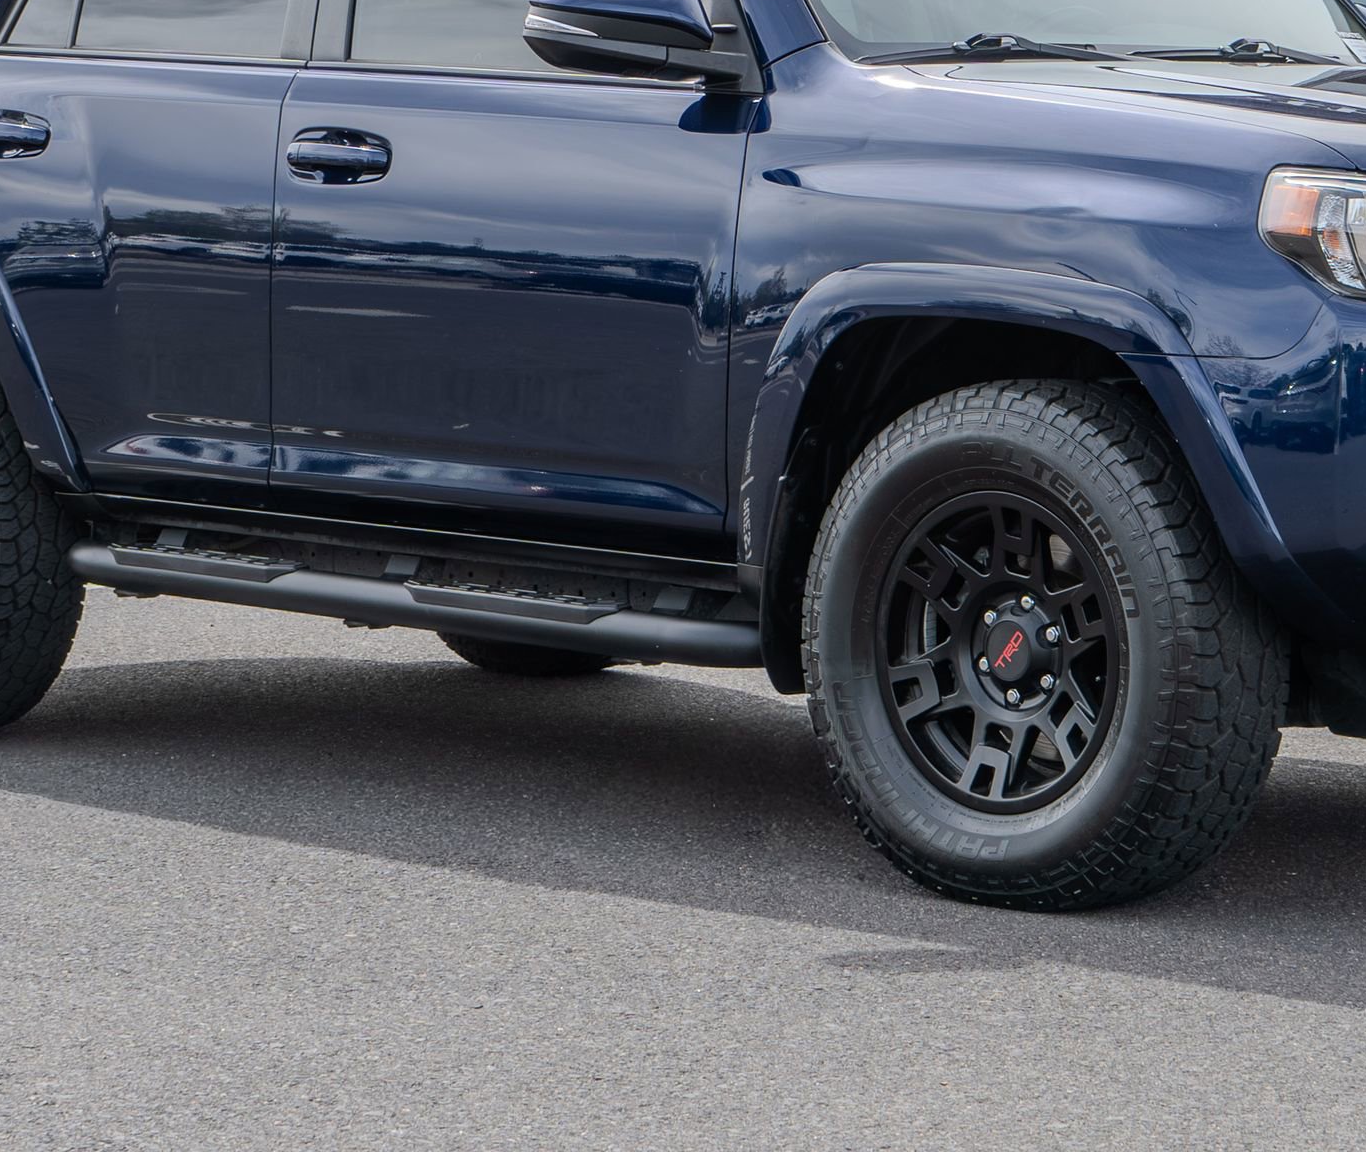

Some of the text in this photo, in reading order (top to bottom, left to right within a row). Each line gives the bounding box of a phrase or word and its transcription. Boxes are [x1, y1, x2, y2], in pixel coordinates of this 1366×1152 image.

[1030, 455, 1141, 619] TERRAIN
[994, 630, 1024, 668] TRD
[833, 680, 1011, 861] PATHFINDER
